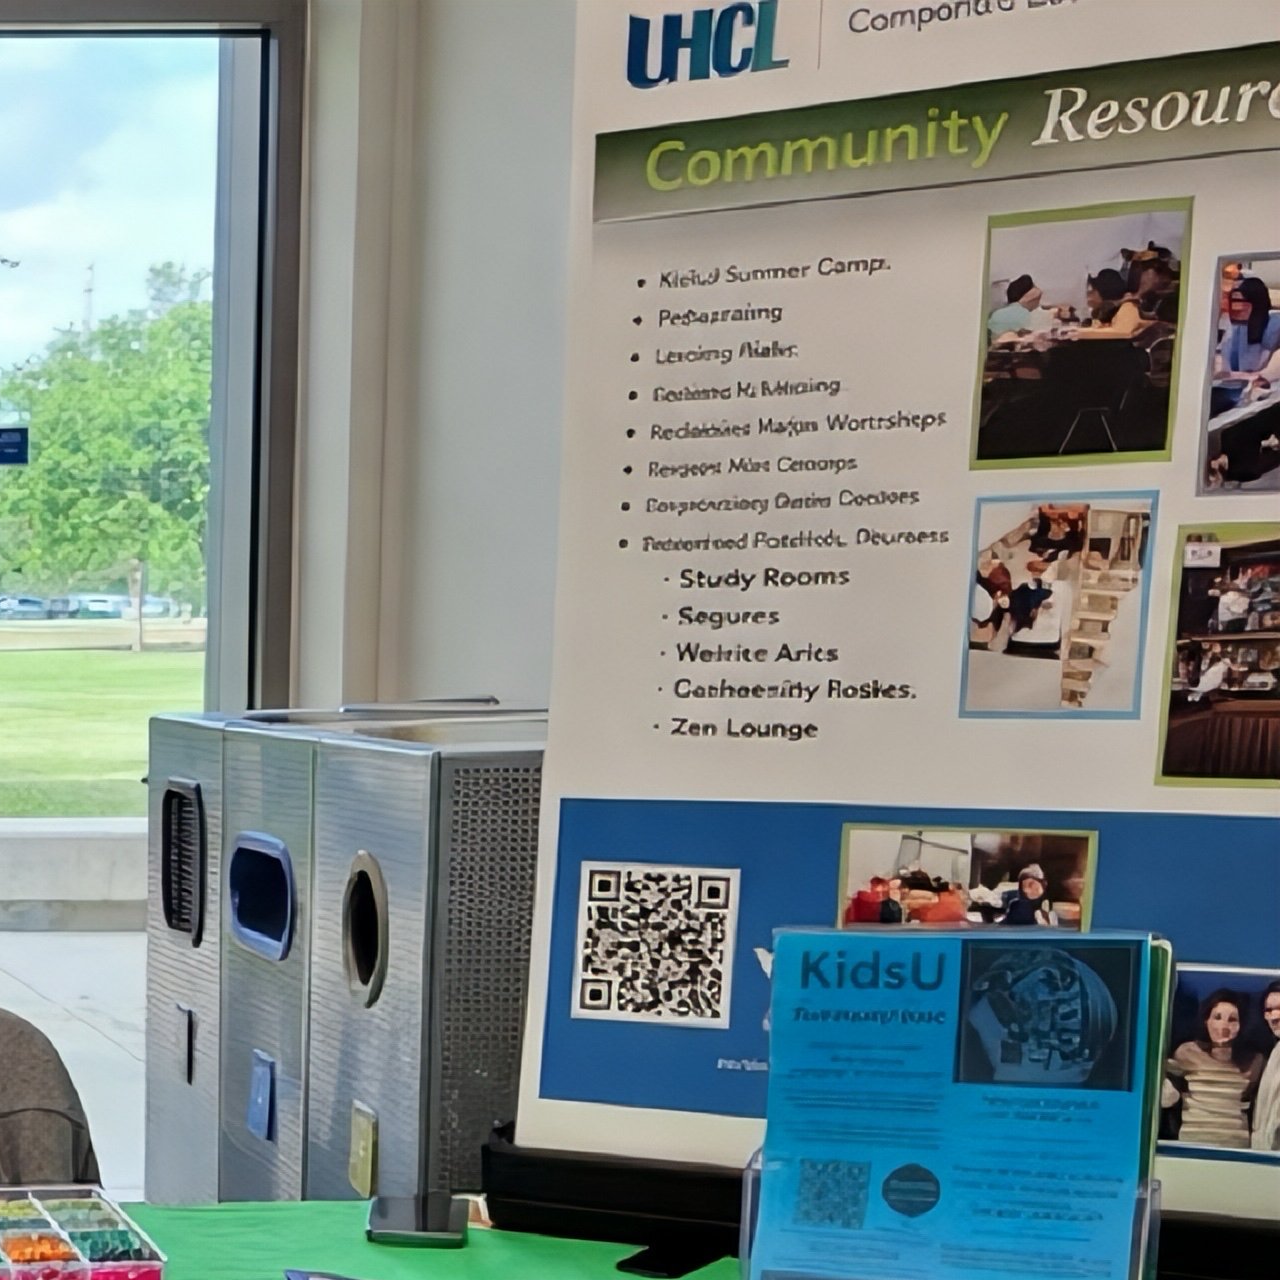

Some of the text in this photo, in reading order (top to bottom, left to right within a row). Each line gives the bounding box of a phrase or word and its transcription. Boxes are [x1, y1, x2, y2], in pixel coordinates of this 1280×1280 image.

[627, 0, 789, 89] UHCL
[646, 107, 1009, 191] Community
[680, 567, 851, 592] Study Rooms
[670, 717, 819, 742] Zen Lounge
[800, 949, 948, 992] KidsU
